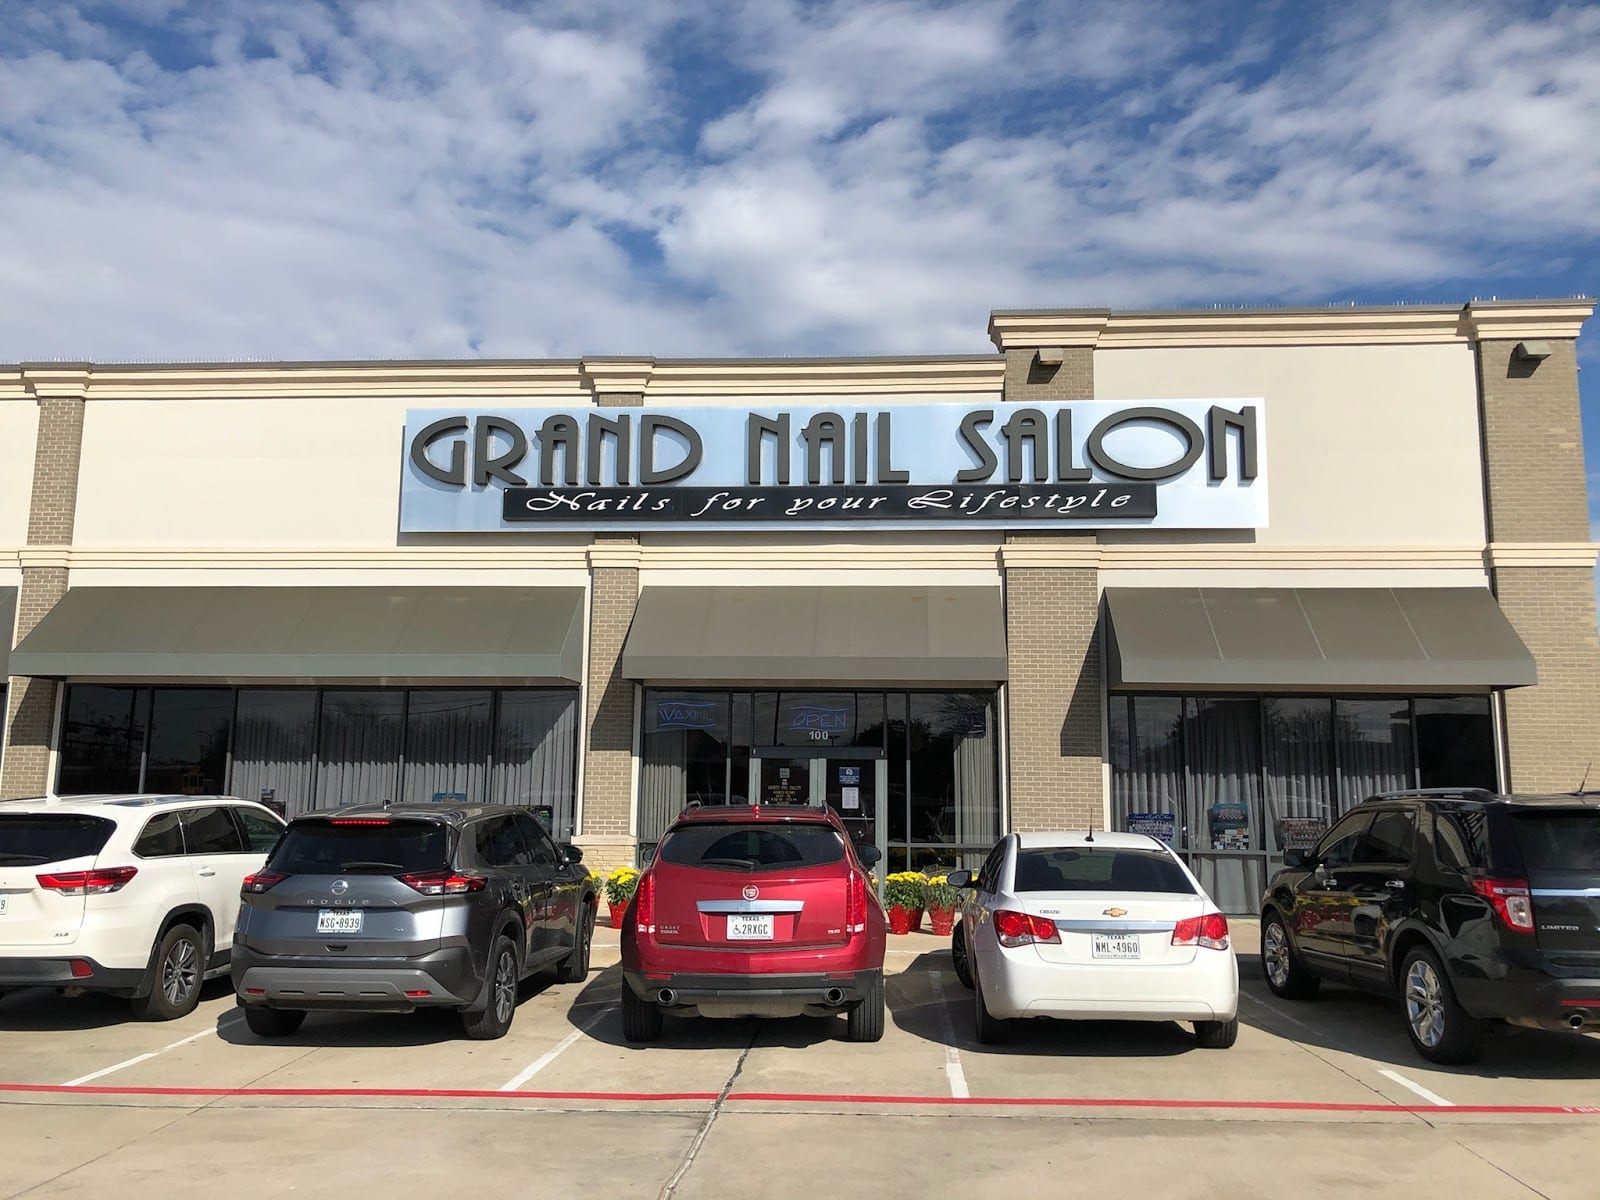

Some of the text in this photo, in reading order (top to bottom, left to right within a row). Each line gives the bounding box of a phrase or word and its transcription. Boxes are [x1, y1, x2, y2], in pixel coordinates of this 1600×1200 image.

[410, 405, 1257, 486] GRAND NAIL SALON
[526, 488, 1131, 516] Nails for your Lifestyle
[792, 711, 847, 728] OPEN
[808, 730, 829, 741] 100
[742, 924, 769, 936] 2RXGC
